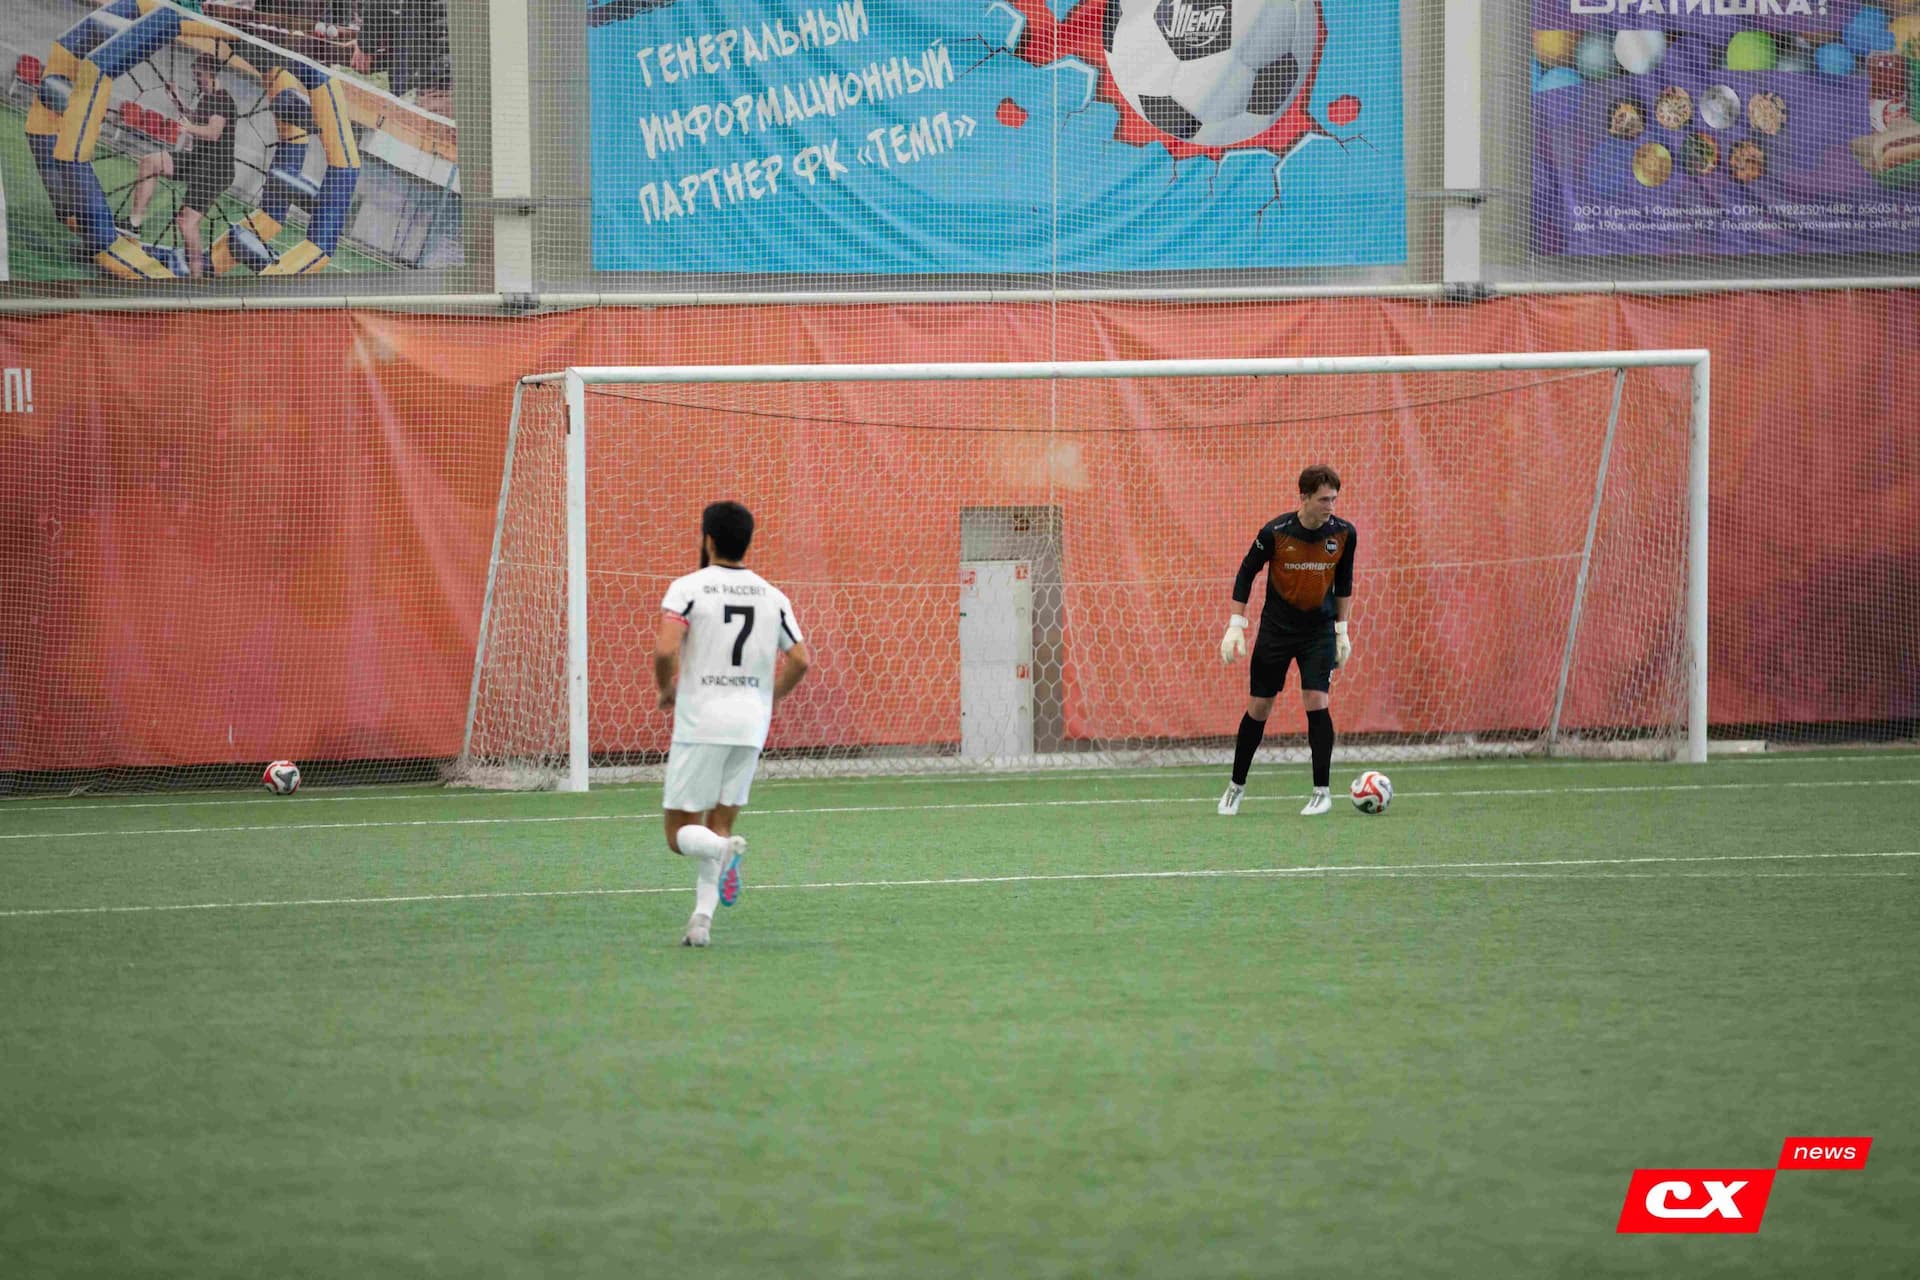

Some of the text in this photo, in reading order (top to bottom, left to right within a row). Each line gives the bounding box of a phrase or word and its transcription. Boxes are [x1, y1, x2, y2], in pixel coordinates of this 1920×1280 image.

[636, 0, 869, 87] ГЕНЕРАЛЬНЫЙ
[639, 38, 955, 159] ИНФОРМАЦИОННЫЙ
[638, 111, 977, 225] ПАРТНЕР ФК «ТЕМП»
[1573, 205, 1601, 216] ООО
[724, 605, 755, 667] 7
